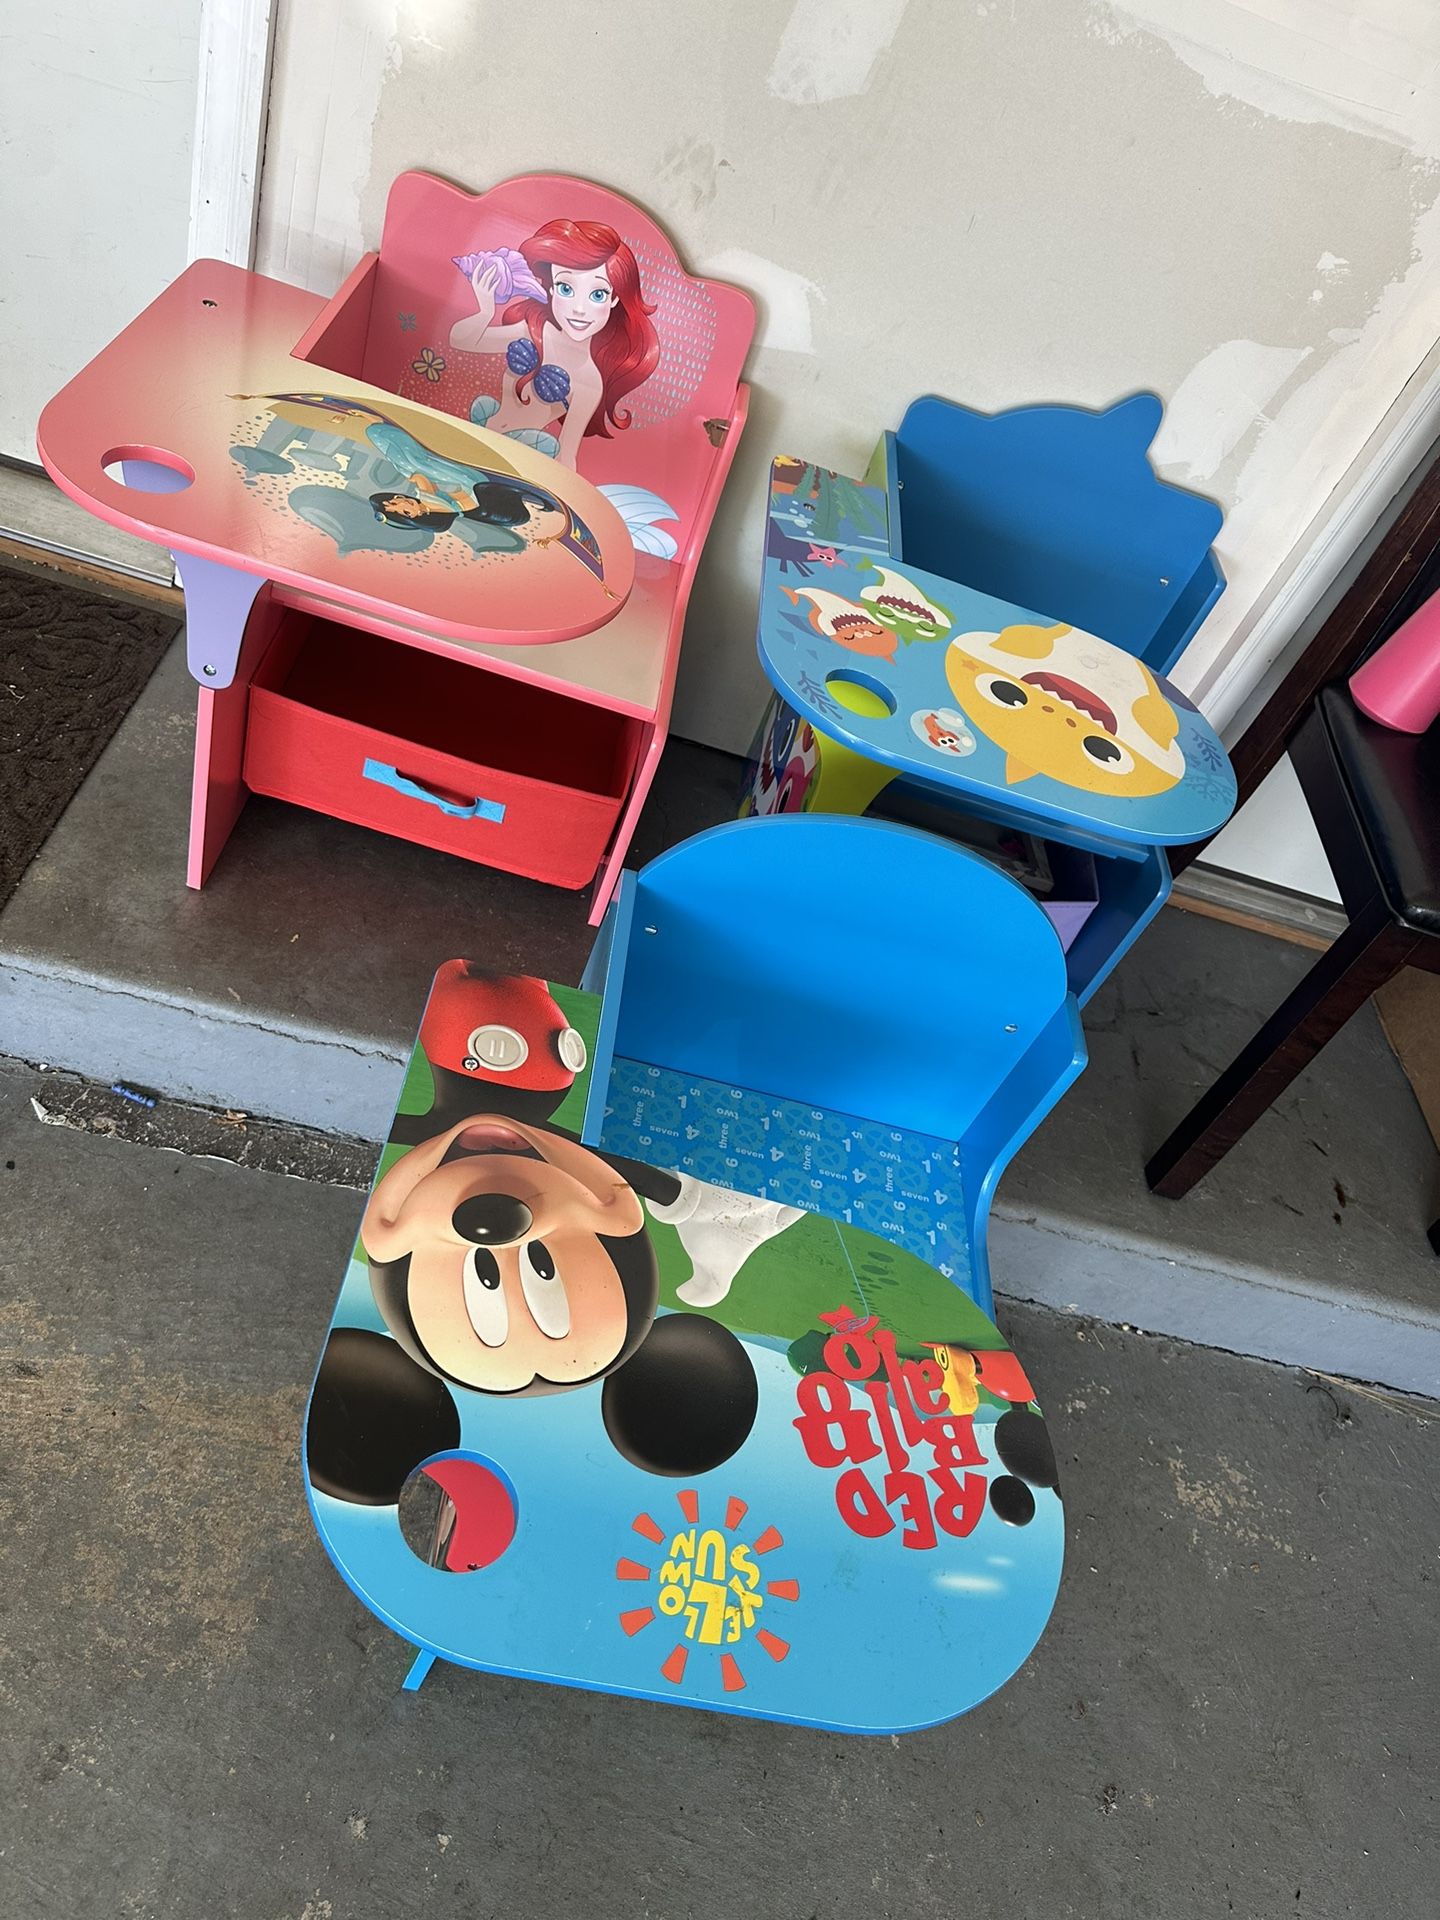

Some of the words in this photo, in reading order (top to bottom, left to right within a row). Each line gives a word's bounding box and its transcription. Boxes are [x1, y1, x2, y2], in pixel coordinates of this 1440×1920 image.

[632, 1085, 656, 1099] two
[690, 1087, 701, 1096] 5
[678, 1095, 687, 1109] 1
[633, 1100, 645, 1127] three
[717, 1107, 739, 1120] two
[772, 1109, 783, 1119] 5
[761, 1116, 770, 1131] 1
[650, 1125, 680, 1138] seven
[685, 1124, 700, 1141] 4
[719, 1123, 729, 1149] three
[799, 1129, 821, 1142] two
[851, 1131, 863, 1140] 5
[842, 1138, 851, 1152] 1
[735, 1147, 765, 1160] seven
[770, 1146, 784, 1162] 4
[803, 1144, 812, 1171] three
[879, 1150, 902, 1163] two
[931, 1152, 942, 1161] 5
[683, 1156, 694, 1166] 5
[921, 1159, 931, 1174] 1
[819, 1168, 848, 1181] seven
[852, 1168, 867, 1184] 4
[885, 1166, 893, 1193] three
[711, 1177, 735, 1189] two
[769, 1178, 780, 1188] 5
[901, 1190, 930, 1203] seven
[934, 1189, 949, 1205] 4
[797, 1199, 821, 1213] two
[853, 1200, 865, 1210] 5
[842, 1208, 852, 1224] 1
[881, 1221, 905, 1234] two
[936, 1221, 947, 1231] 5
[926, 1230, 936, 1246] 1
[835, 1467, 988, 1550] RED
[669, 1529, 760, 1590] SUN
[658, 1560, 763, 1645] YELLOW
